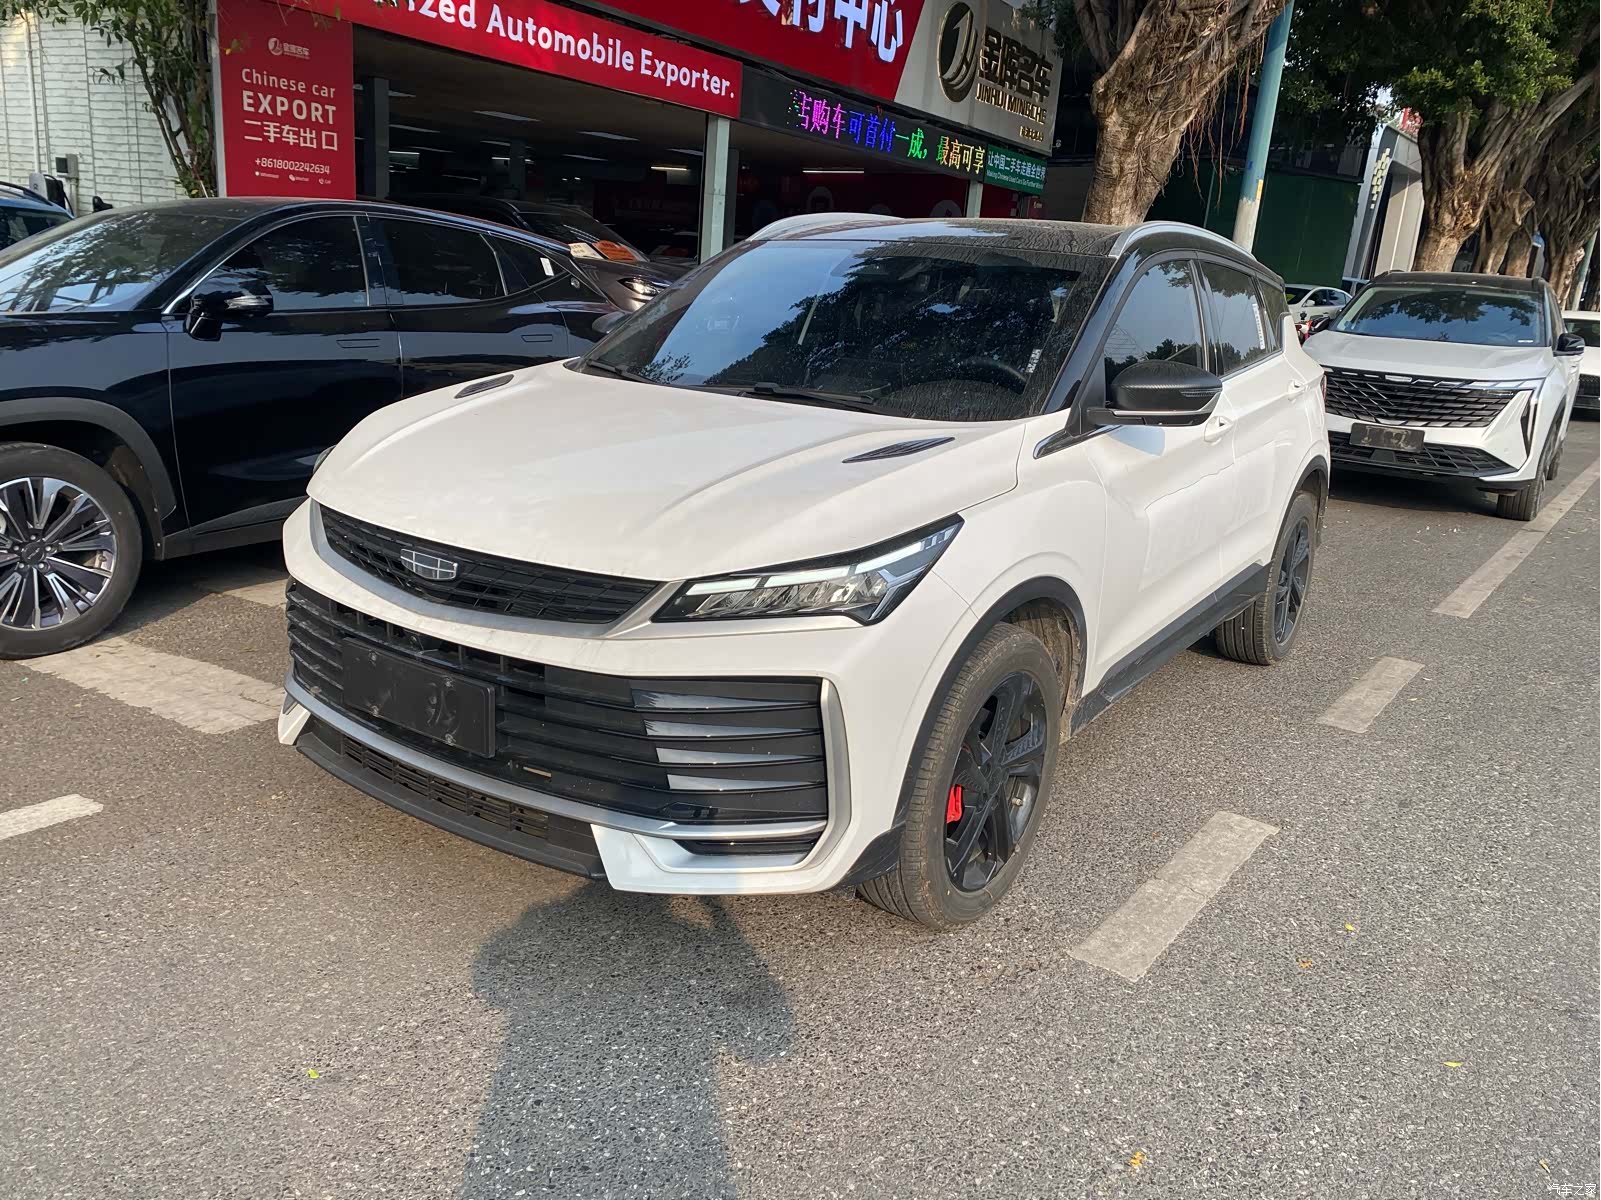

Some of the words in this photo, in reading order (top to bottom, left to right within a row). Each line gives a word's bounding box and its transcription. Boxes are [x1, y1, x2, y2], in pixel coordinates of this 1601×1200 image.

[486, 4, 634, 71] Automobile
[640, 48, 735, 98] Exporter.
[242, 68, 306, 93] Chinese
[312, 84, 336, 98] car
[242, 90, 336, 124] EXPORT
[244, 119, 338, 151] 二手车出口
[255, 157, 330, 174] +8618002242634
